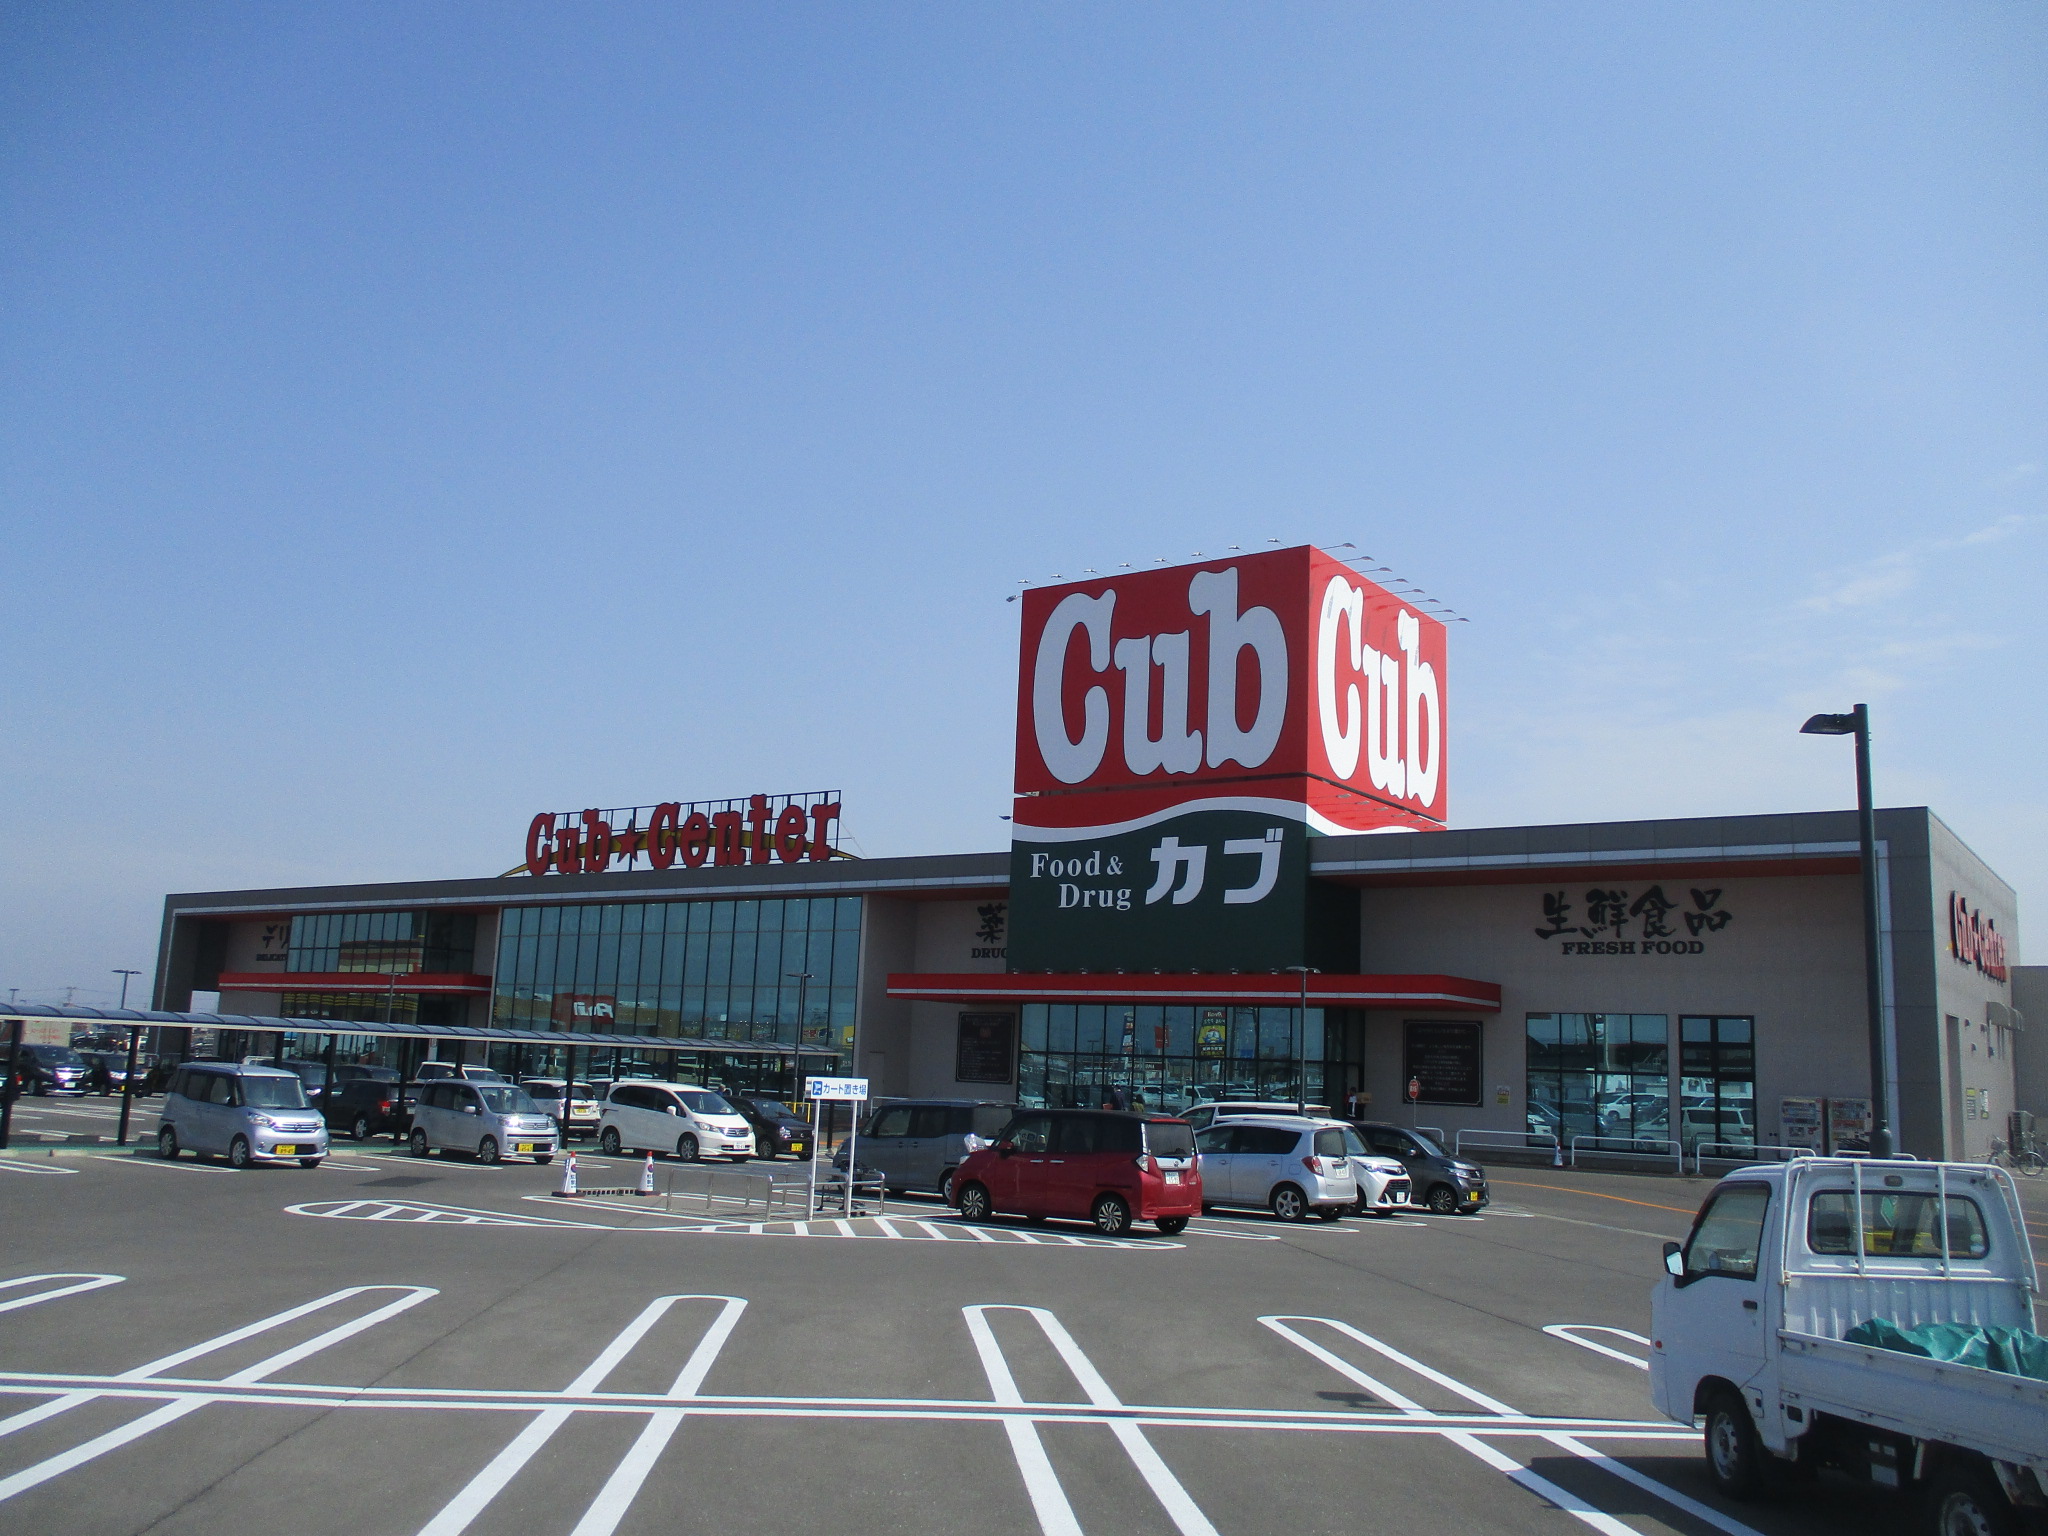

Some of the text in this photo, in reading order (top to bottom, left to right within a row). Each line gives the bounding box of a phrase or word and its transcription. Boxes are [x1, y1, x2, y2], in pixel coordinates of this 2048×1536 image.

[1032, 565, 1290, 784] Cub
[1317, 573, 1441, 808] Cub
[526, 794, 842, 876] Cub Center
[1145, 827, 1283, 905] カブ
[1058, 883, 1132, 911] Drug
[1534, 884, 1733, 940] 生鮮食品
[1562, 941, 1705, 956] FRESH FOOD
